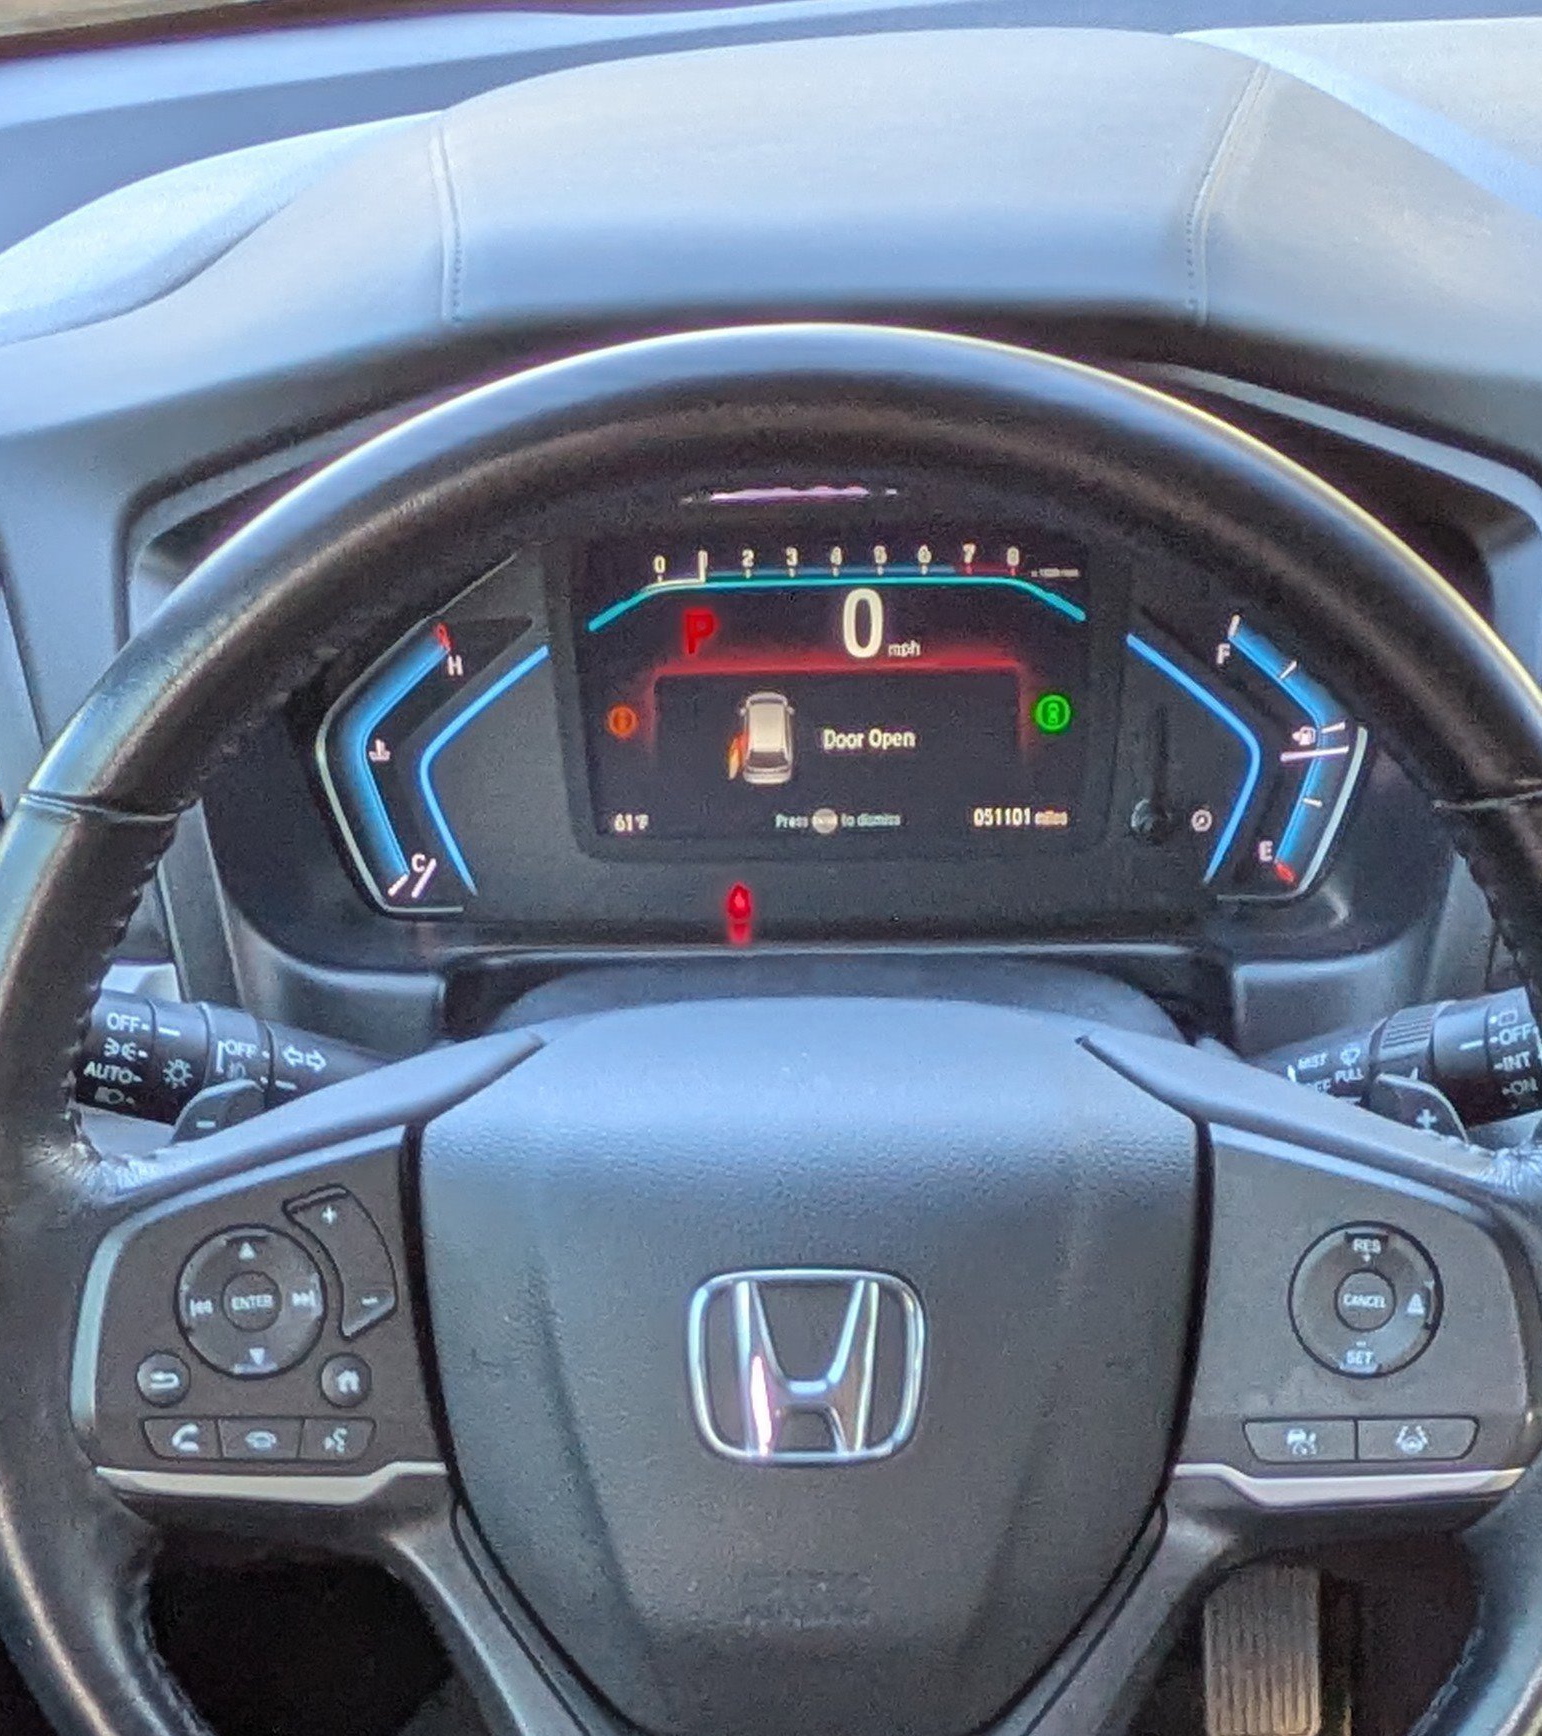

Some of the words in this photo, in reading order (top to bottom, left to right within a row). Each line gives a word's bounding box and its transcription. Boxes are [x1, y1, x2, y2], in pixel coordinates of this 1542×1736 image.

[742, 549, 755, 568] 2
[786, 546, 799, 566] 3
[917, 544, 932, 564] 6
[962, 542, 977, 564] 7
[685, 612, 715, 654] P
[842, 588, 884, 659] 0
[888, 641, 921, 657] mph
[1216, 643, 1231, 665] F
[446, 655, 464, 677] H
[822, 729, 865, 749] Door
[868, 729, 917, 751] Open
[775, 813, 809, 828] Press
[973, 807, 1031, 827] 051101
[1259, 840, 1274, 862] E
[411, 853, 426, 873] C
[107, 1013, 141, 1034] OFF
[1500, 1022, 1535, 1046] OFF
[224, 1038, 259, 1059] OFF
[1502, 1050, 1531, 1072] INT
[83, 1061, 133, 1085] AUTO
[1509, 1077, 1539, 1095] ON
[1352, 1238, 1382, 1254] RES
[230, 1294, 273, 1311] ENTER
[1342, 1292, 1387, 1309] CANCEL
[1345, 1350, 1374, 1365] SET
